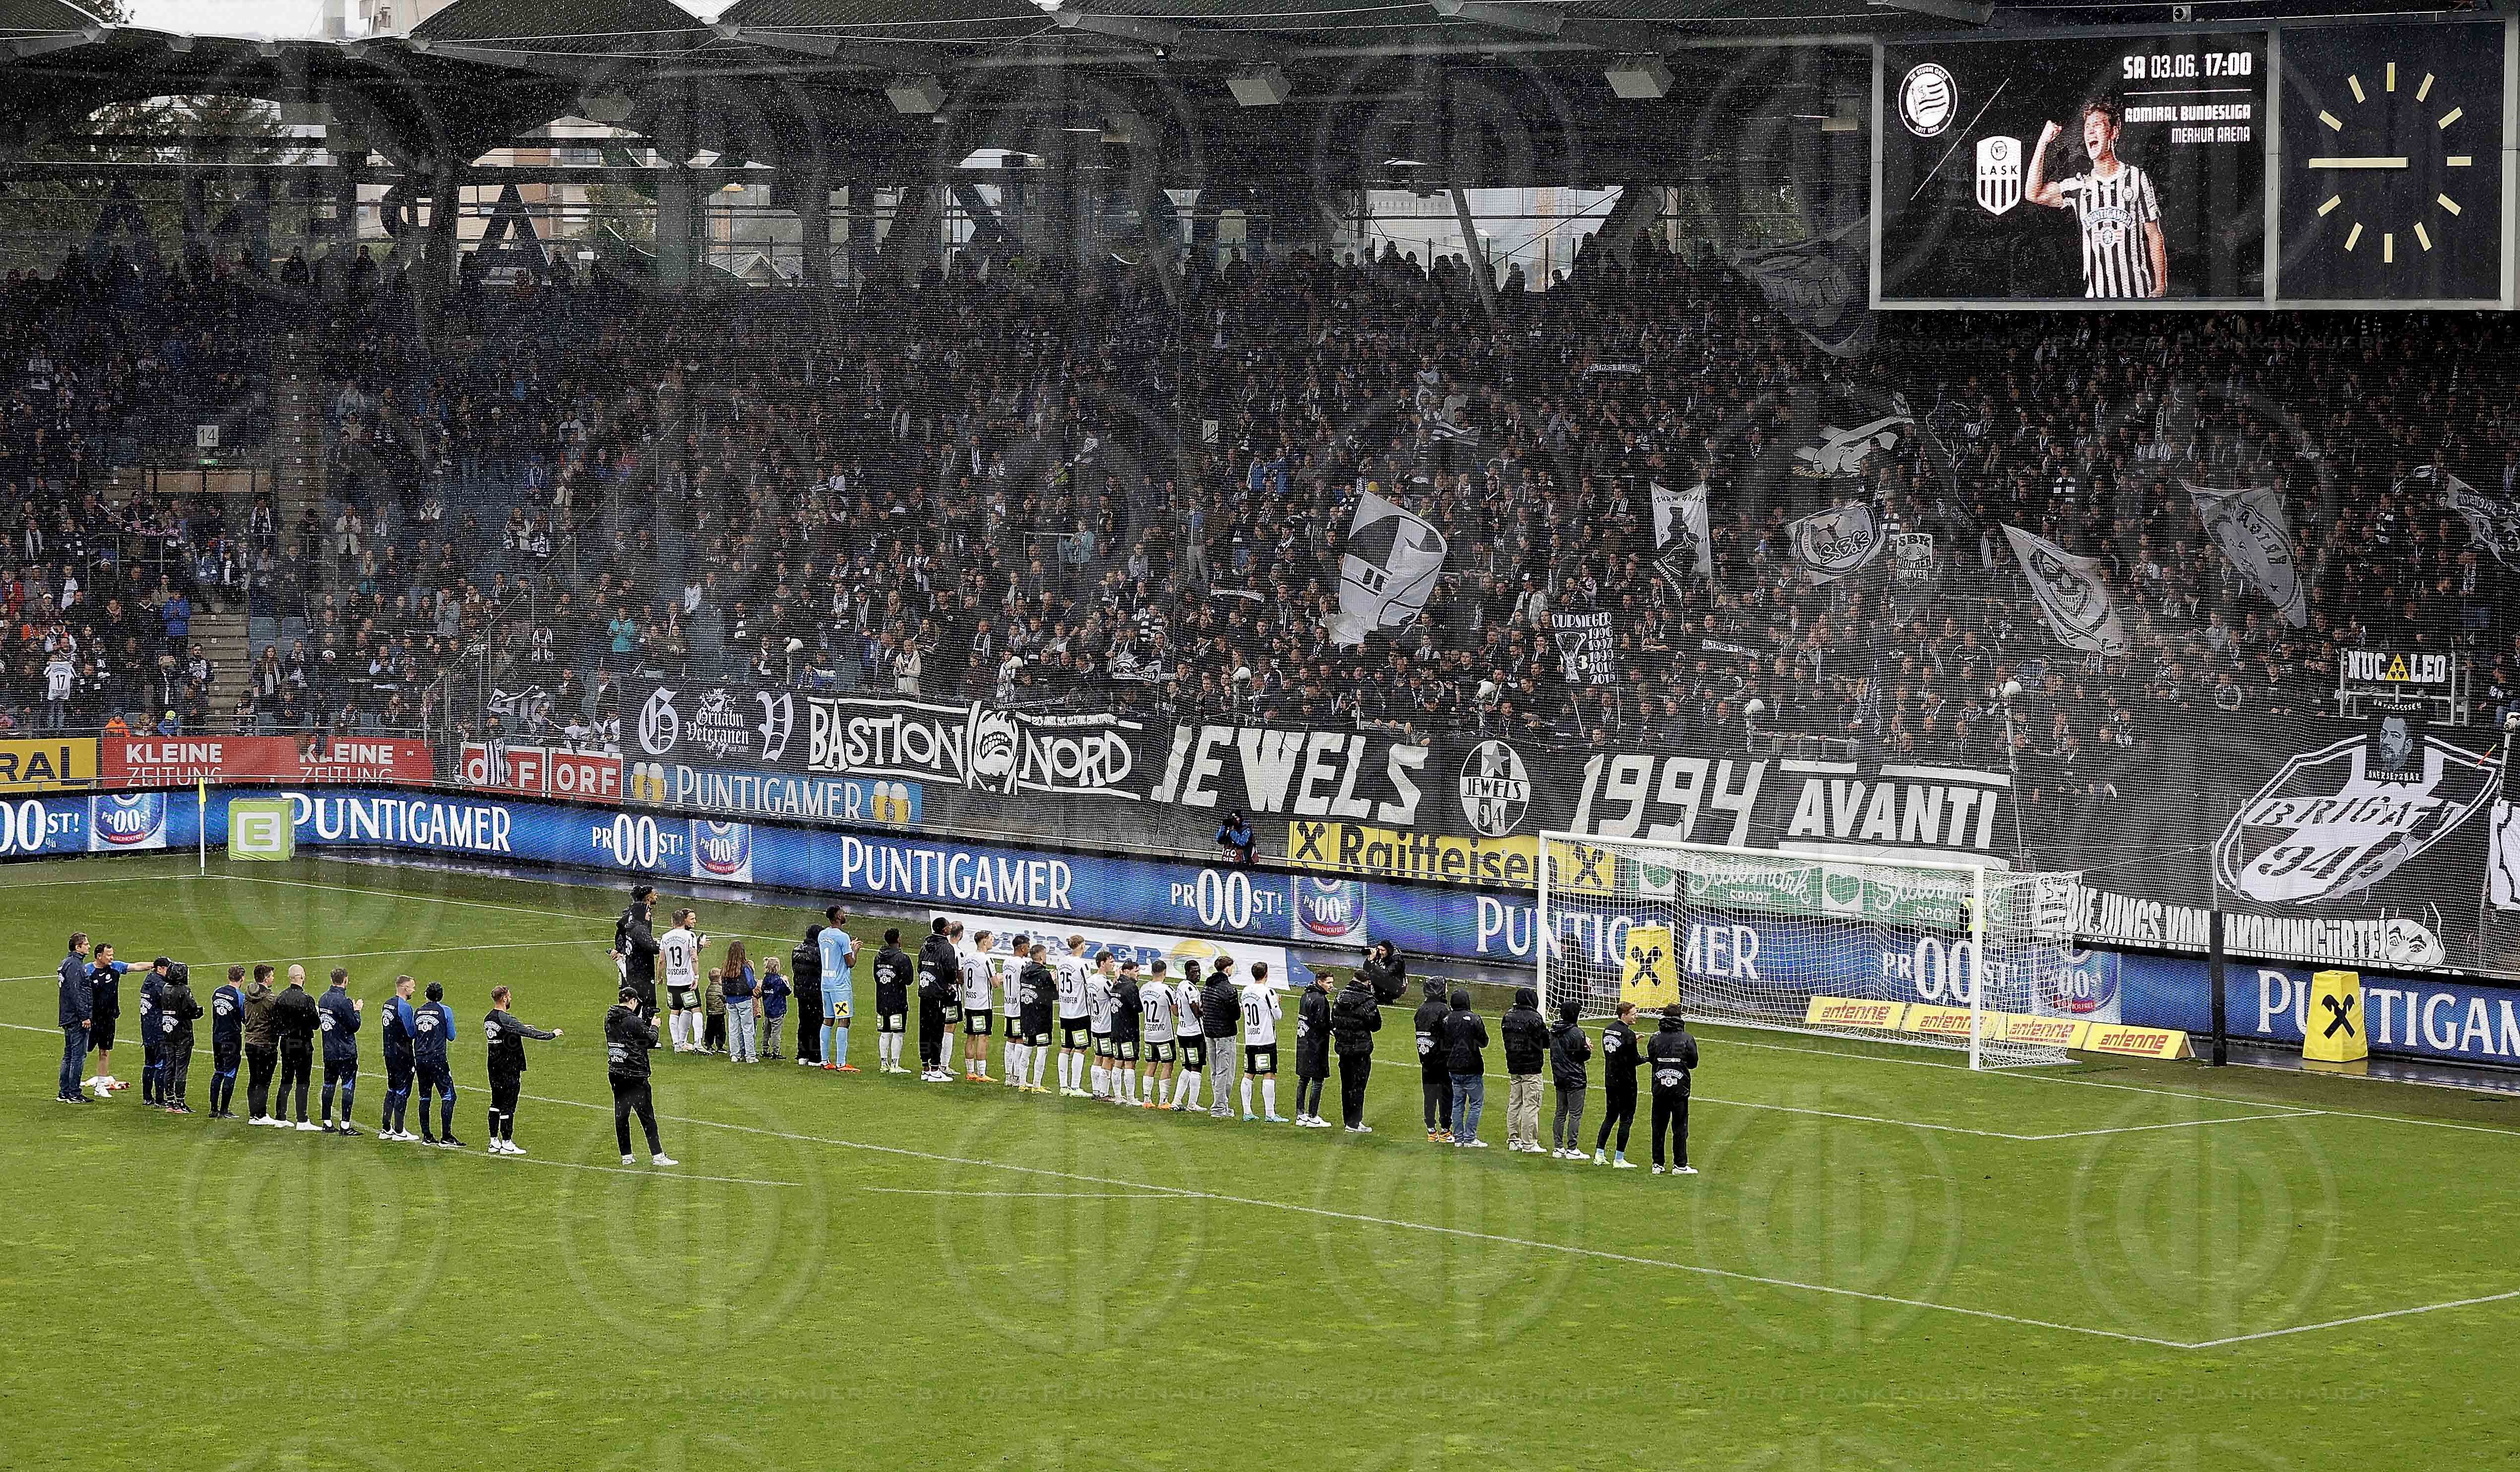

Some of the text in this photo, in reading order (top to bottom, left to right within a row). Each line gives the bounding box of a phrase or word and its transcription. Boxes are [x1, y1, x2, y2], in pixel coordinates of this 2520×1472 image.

[2124, 52, 2251, 79] SA 03.06. 17:00
[2125, 105, 2251, 122] ADMIRAL BUNDESLIGA
[2171, 126, 2250, 143] MERKUR ARENA
[1981, 166, 2018, 175] LASK
[199, 428, 216, 443] 14
[1898, 535, 1930, 547] SBK
[1552, 612, 1612, 628] CUPSIEGER
[1588, 626, 1613, 639] 1996
[1588, 638, 1613, 651] 1997
[1588, 649, 1614, 662] 1999
[56, 675, 65, 689] 17
[685, 720, 750, 744] Veteranen
[126, 743, 394, 764] KLEINE KLEINE
[809, 699, 1132, 790] BASTION NORD
[126, 767, 223, 787] ZEITUNG
[557, 759, 617, 796] ORF
[1150, 725, 1997, 849] JEWELS 1994 AVANTI
[676, 764, 862, 820] PUNTIGAMER
[1465, 777, 1521, 800] JEWELS
[280, 792, 511, 852] PUNTIGAMER
[1479, 804, 1504, 834] 94
[1339, 823, 1558, 887] Raiffeisen
[841, 836, 1072, 911] PUNTIGAMER
[1729, 891, 1960, 921] SPORT SPORT
[2095, 892, 2162, 948] JUNGS
[2166, 906, 2210, 951] VOM
[669, 946, 682, 968] 13
[823, 948, 830, 970] 1
[967, 967, 973, 989] 8
[1005, 974, 1013, 996] 11
[1059, 971, 1072, 994] 35
[1143, 999, 1159, 1024] 22
[1244, 1003, 1259, 1026] 30
[1821, 1002, 1890, 1020] antenne
[2010, 1017, 2075, 1038] antenne
[2099, 1029, 2169, 1049] antenne
[1655, 1068, 1684, 1080] PUNTIGAMER
